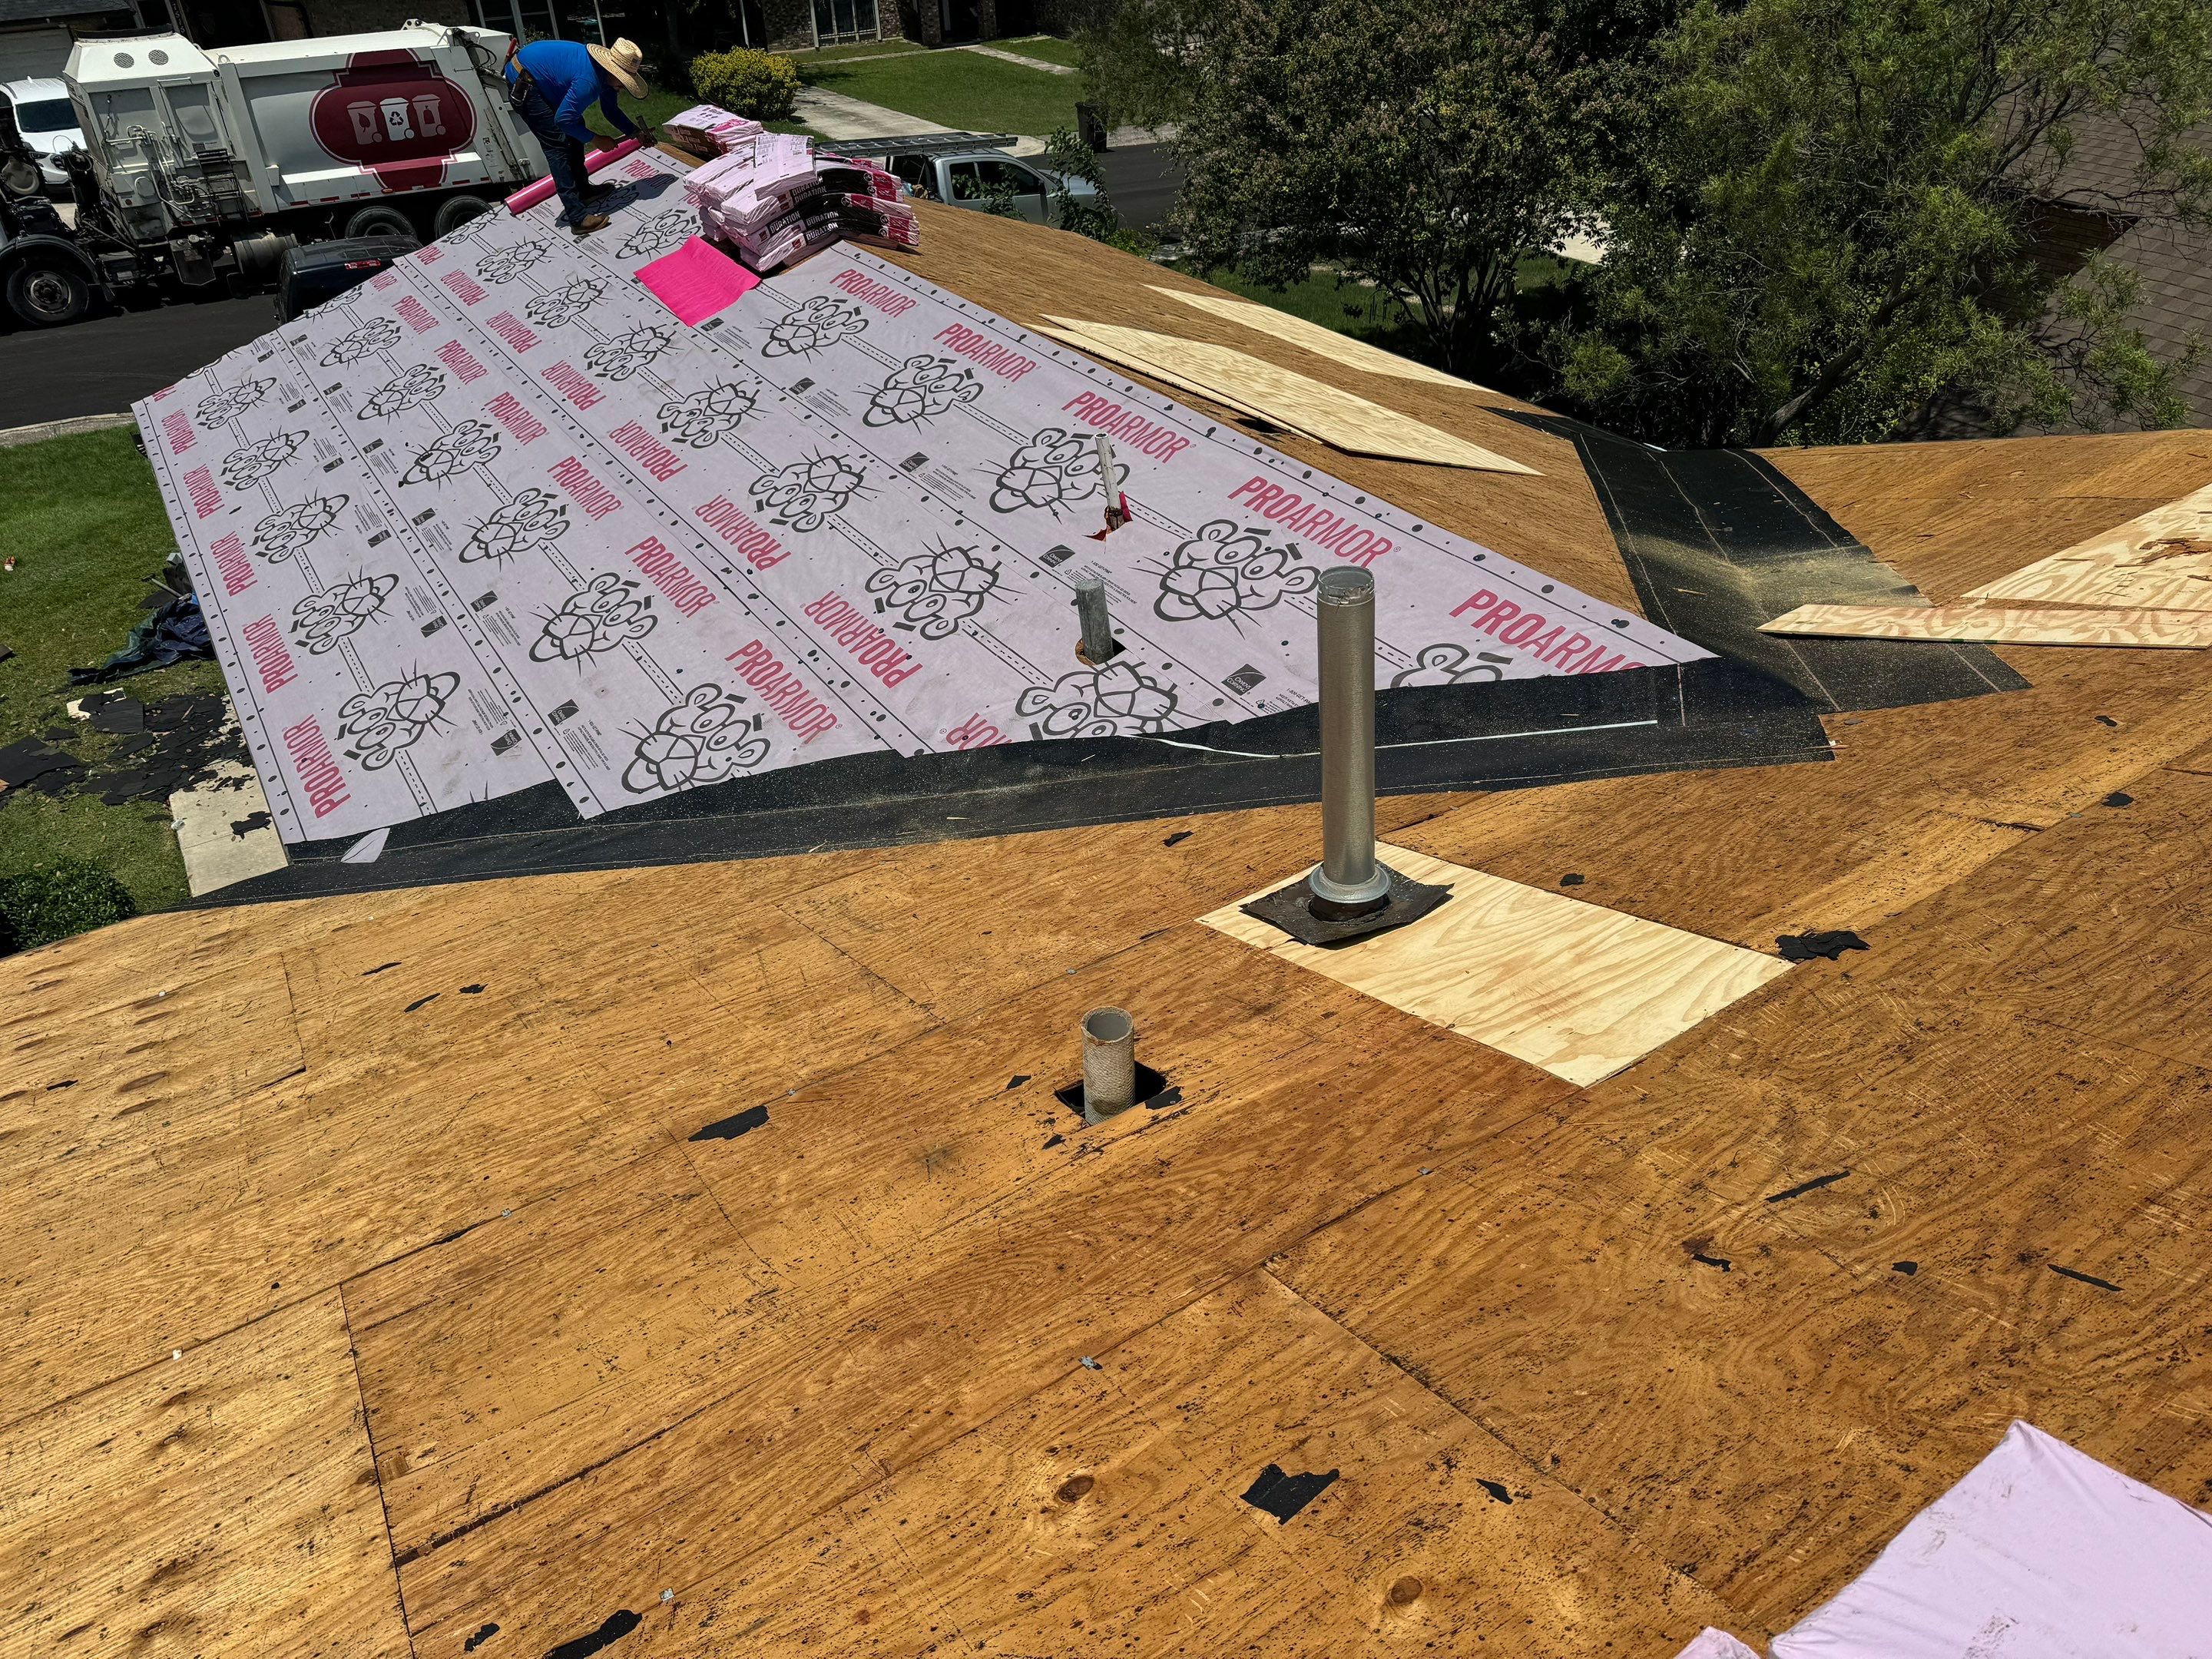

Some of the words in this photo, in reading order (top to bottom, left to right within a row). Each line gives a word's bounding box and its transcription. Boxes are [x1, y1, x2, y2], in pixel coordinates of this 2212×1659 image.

[830, 269, 919, 317] PROARMOR
[434, 339, 488, 385] PROARMOR
[486, 310, 542, 354] PROARMOR
[932, 323, 1037, 382] PROARMOR
[485, 392, 550, 445] PROARMOR
[541, 359, 607, 412] PROARMOR
[609, 419, 688, 482] PROARMOR
[1061, 390, 1190, 463] PROARMOR
[183, 463, 225, 519] PROARMOR
[547, 455, 624, 522] PROARMOR
[1227, 475, 1392, 568] PROARMOR
[210, 530, 258, 598] PROARMOR
[695, 495, 792, 571] PROARMOR
[624, 535, 715, 618] PROARMOR
[243, 614, 298, 694] PROARMOR
[804, 591, 923, 689] PROARMOR
[725, 639, 838, 744] PROARMOR
[283, 714, 352, 819] PROARMOR
